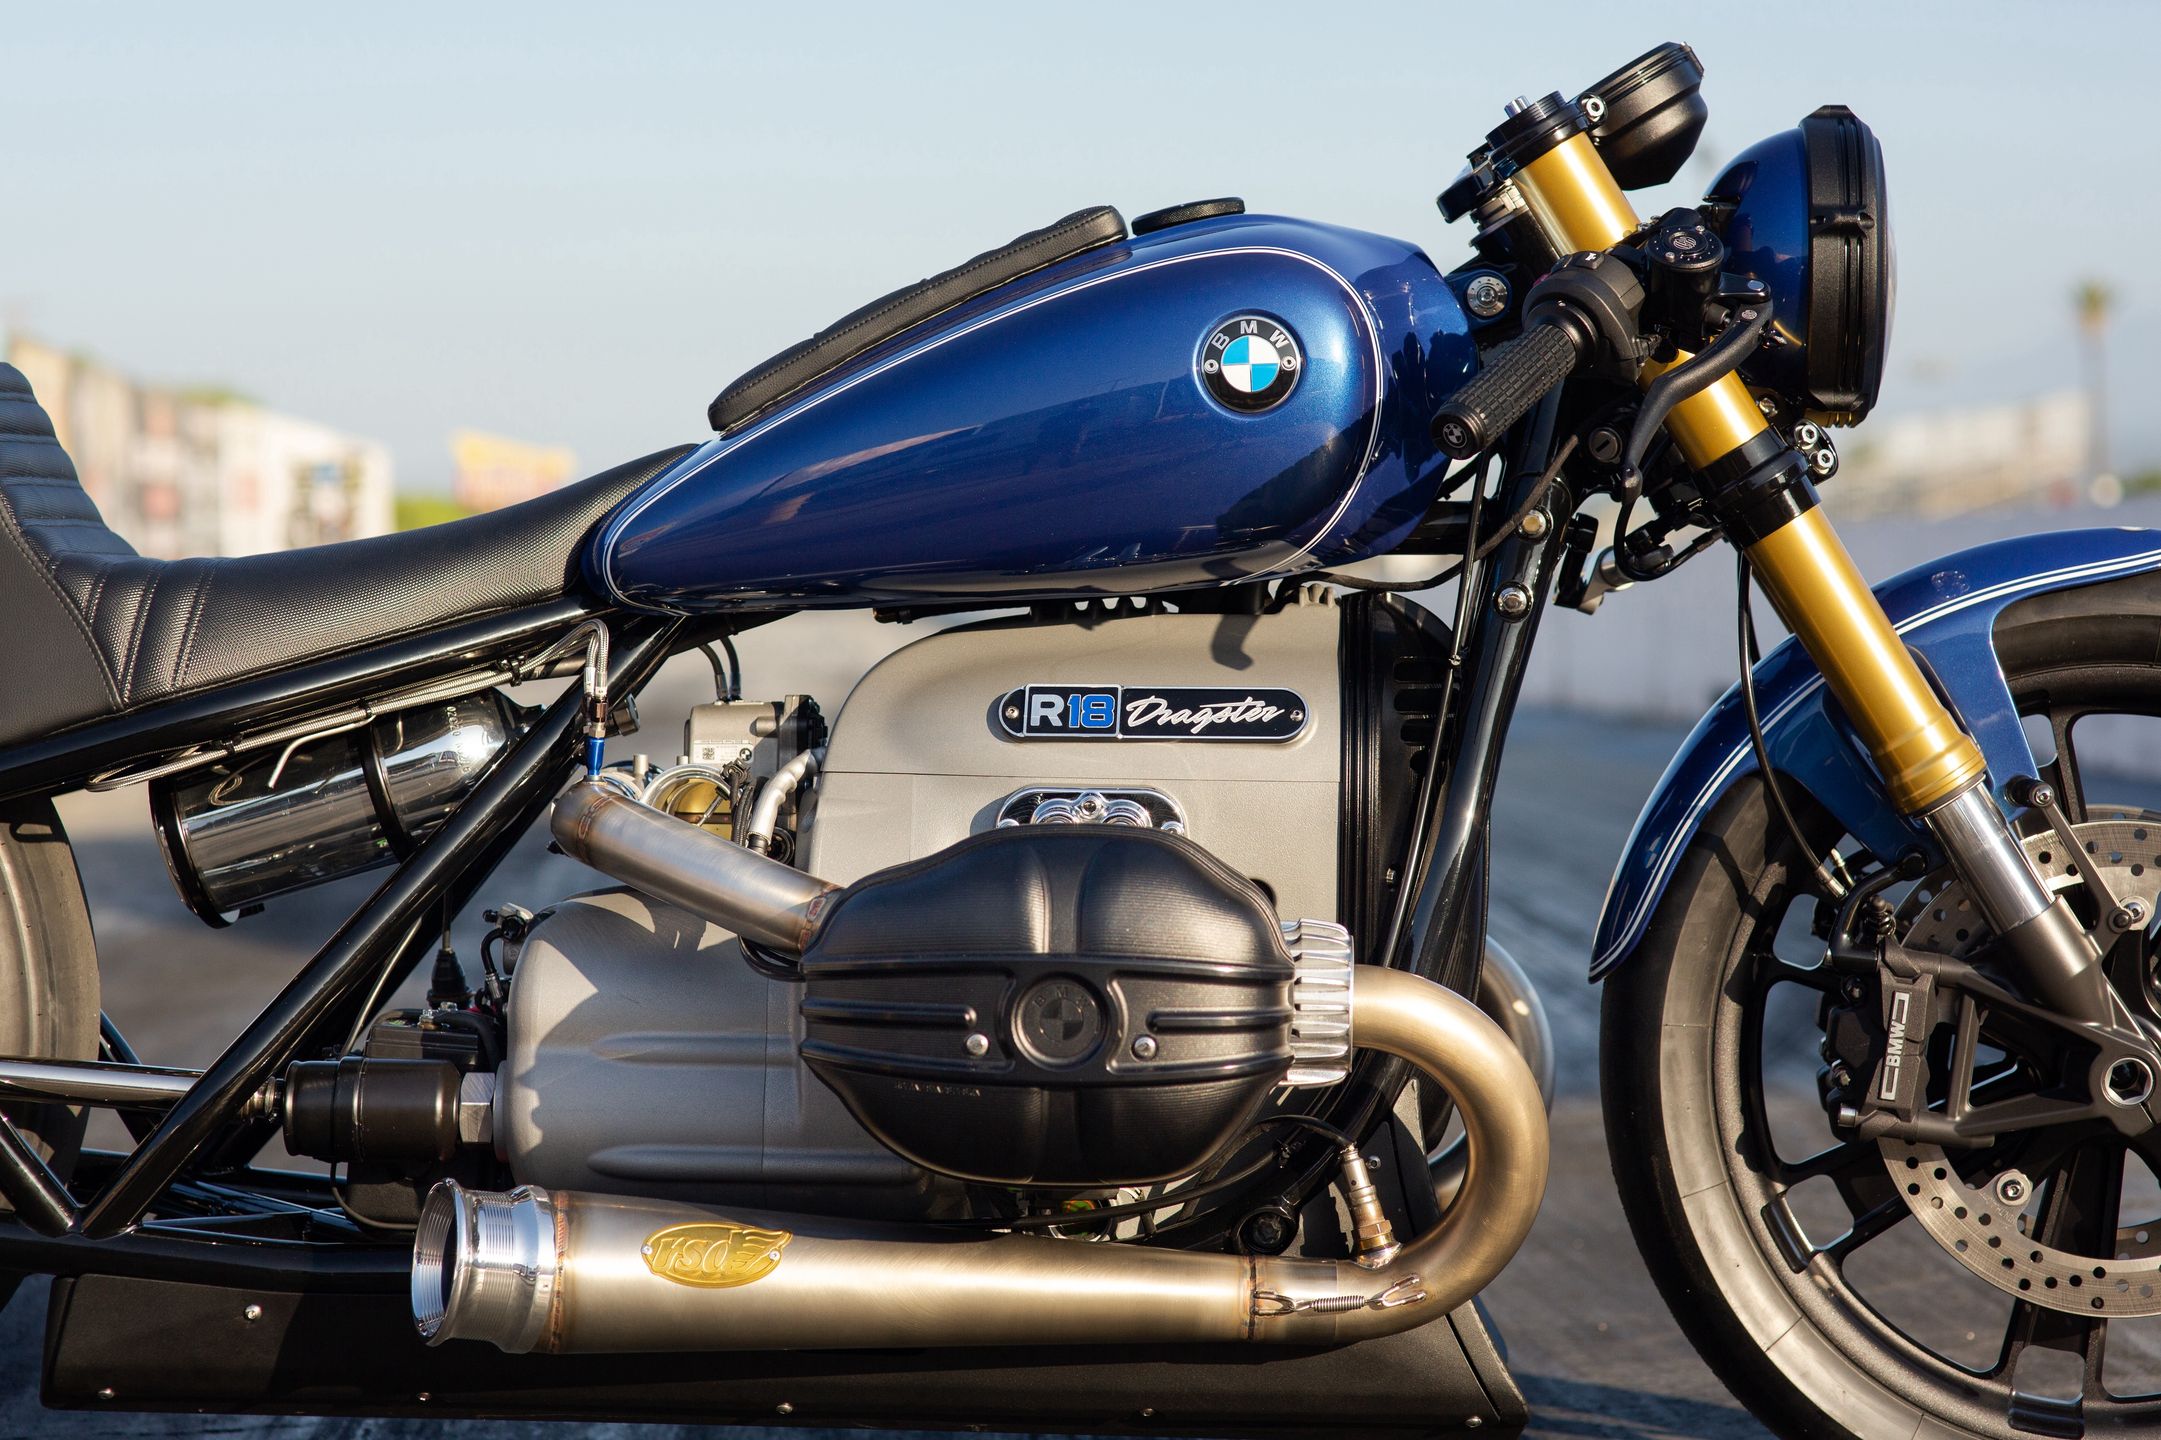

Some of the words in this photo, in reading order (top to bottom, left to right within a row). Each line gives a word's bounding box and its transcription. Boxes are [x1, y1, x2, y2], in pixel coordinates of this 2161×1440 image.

[1211, 320, 1290, 351] BMW
[1030, 693, 1116, 729] R18
[1125, 696, 1285, 735] Dragster
[1885, 1020, 1906, 1068] BMW
